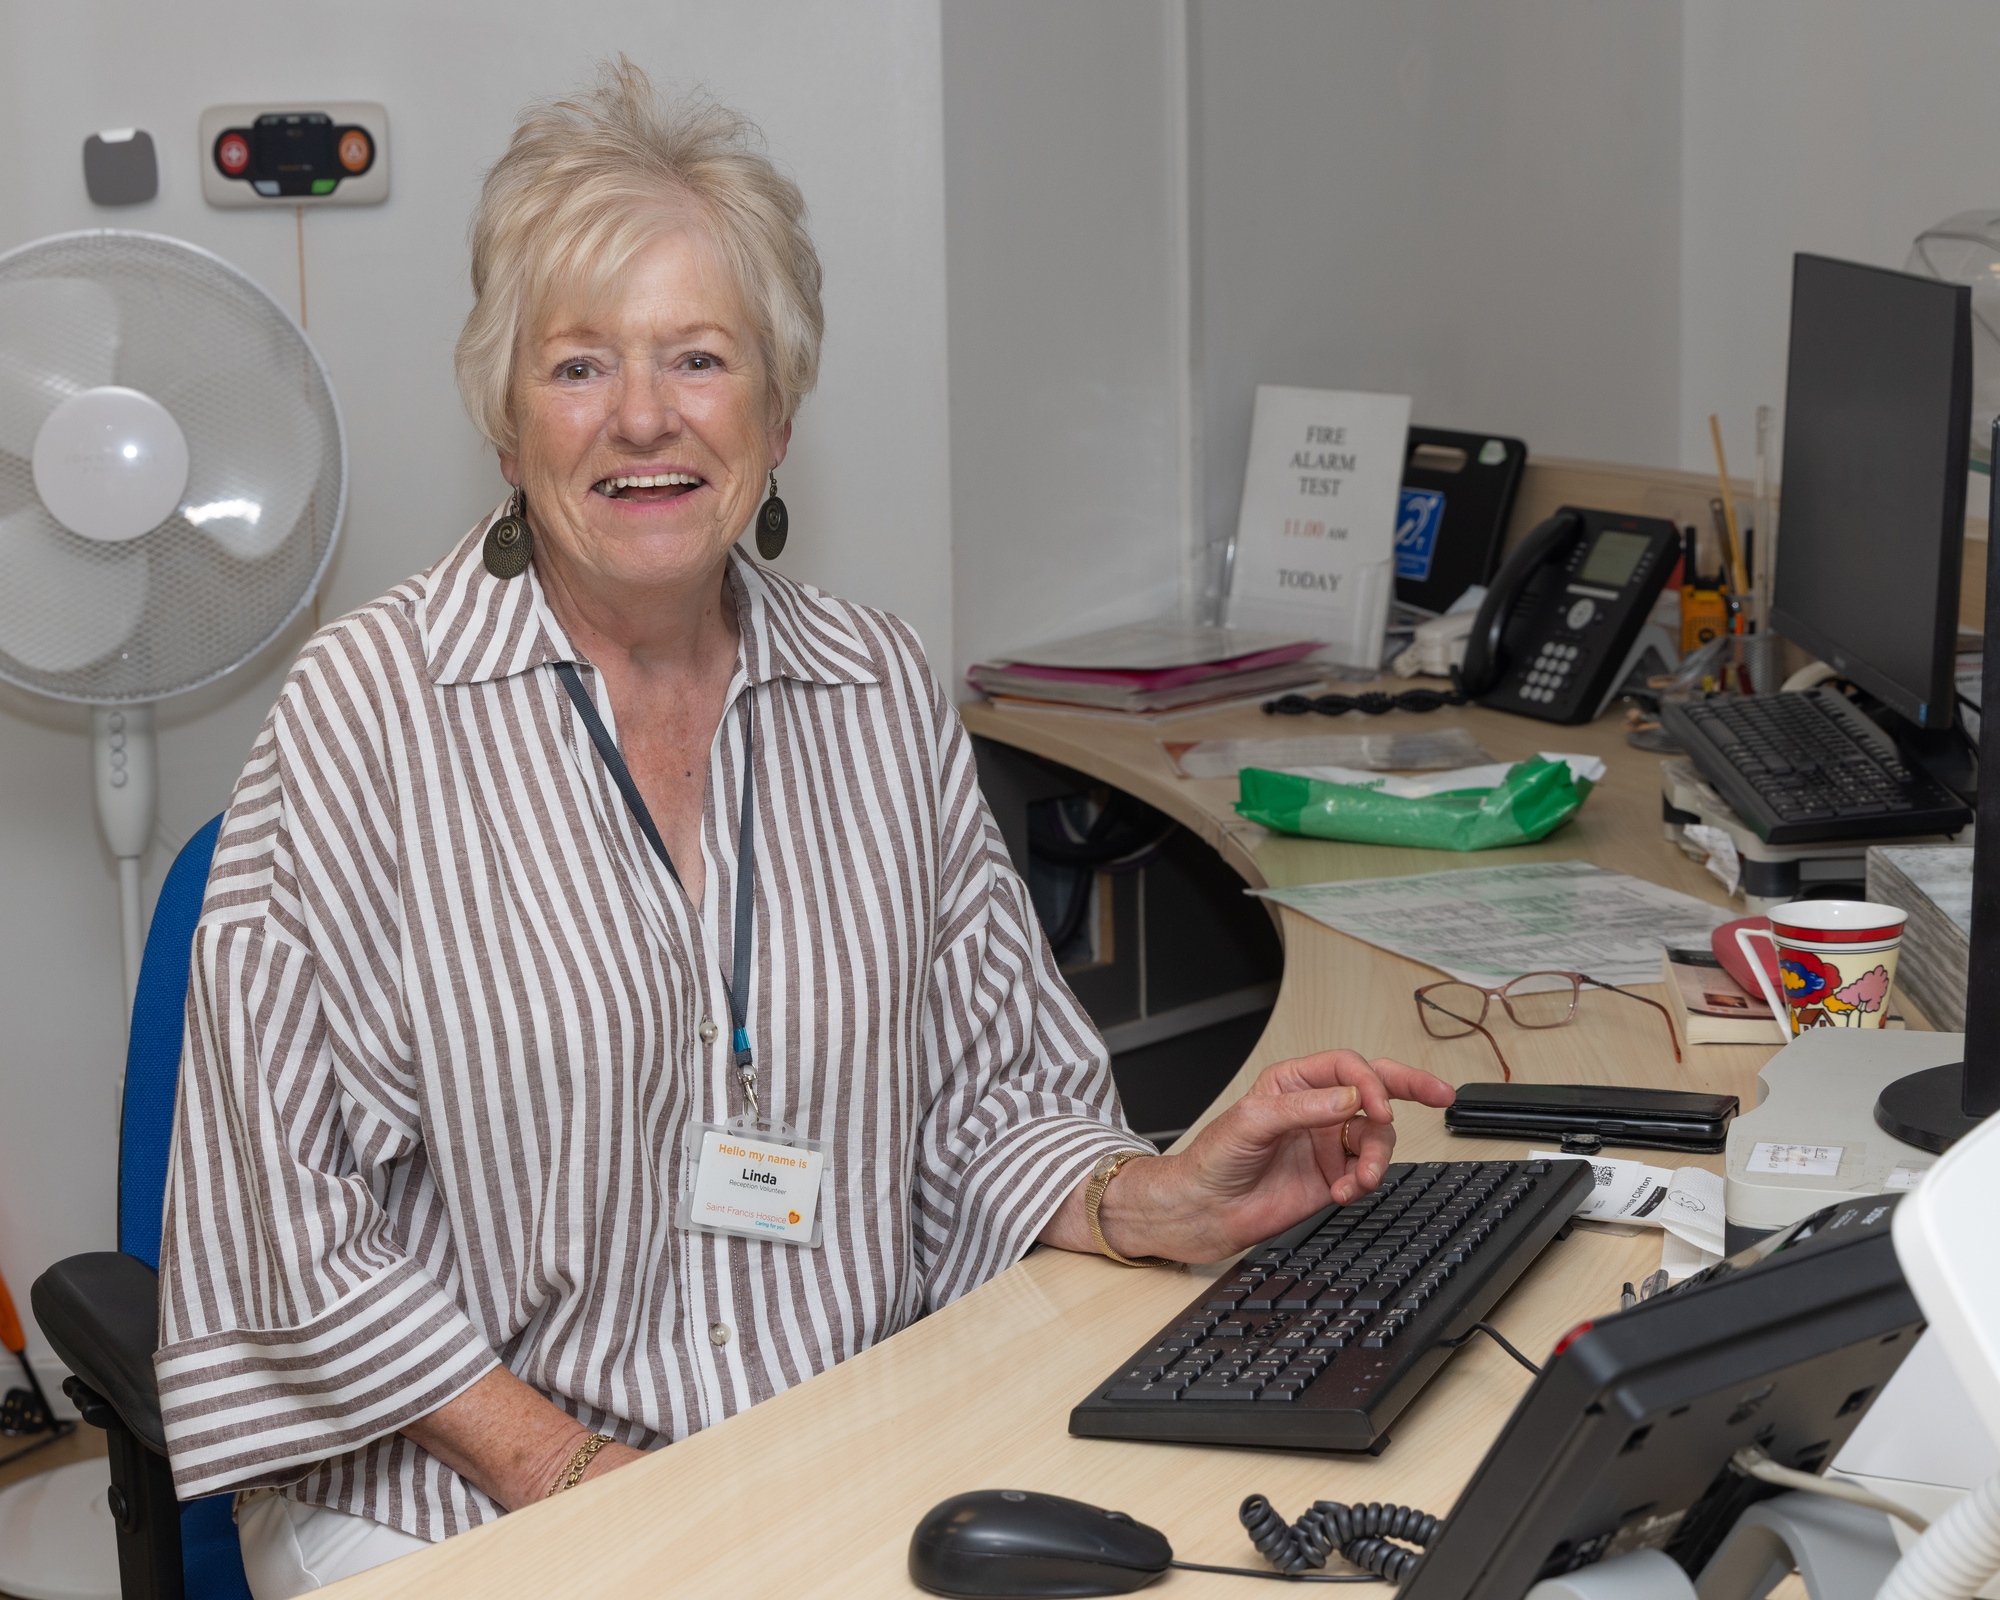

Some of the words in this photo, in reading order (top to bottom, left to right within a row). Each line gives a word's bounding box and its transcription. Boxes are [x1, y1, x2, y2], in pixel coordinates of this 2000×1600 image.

[1306, 425, 1346, 445] FIRE
[1290, 451, 1357, 472] ALARM
[1298, 477, 1343, 496] TEST
[1284, 519, 1325, 538] 11.00
[1327, 527, 1349, 540] AM
[1277, 568, 1342, 591] TODAY
[719, 1143, 746, 1157] Hello
[749, 1150, 765, 1162] my
[767, 1153, 796, 1166] name
[799, 1158, 807, 1169] is
[729, 1179, 759, 1191] Reception
[759, 1185, 786, 1195] Volunteer
[742, 1168, 777, 1185] Linda
[1632, 1176, 1652, 1198] Clifton
[706, 1202, 725, 1213] Saint
[727, 1205, 755, 1218] Francis
[756, 1211, 787, 1225] Hospice
[755, 1220, 769, 1229] Caring
